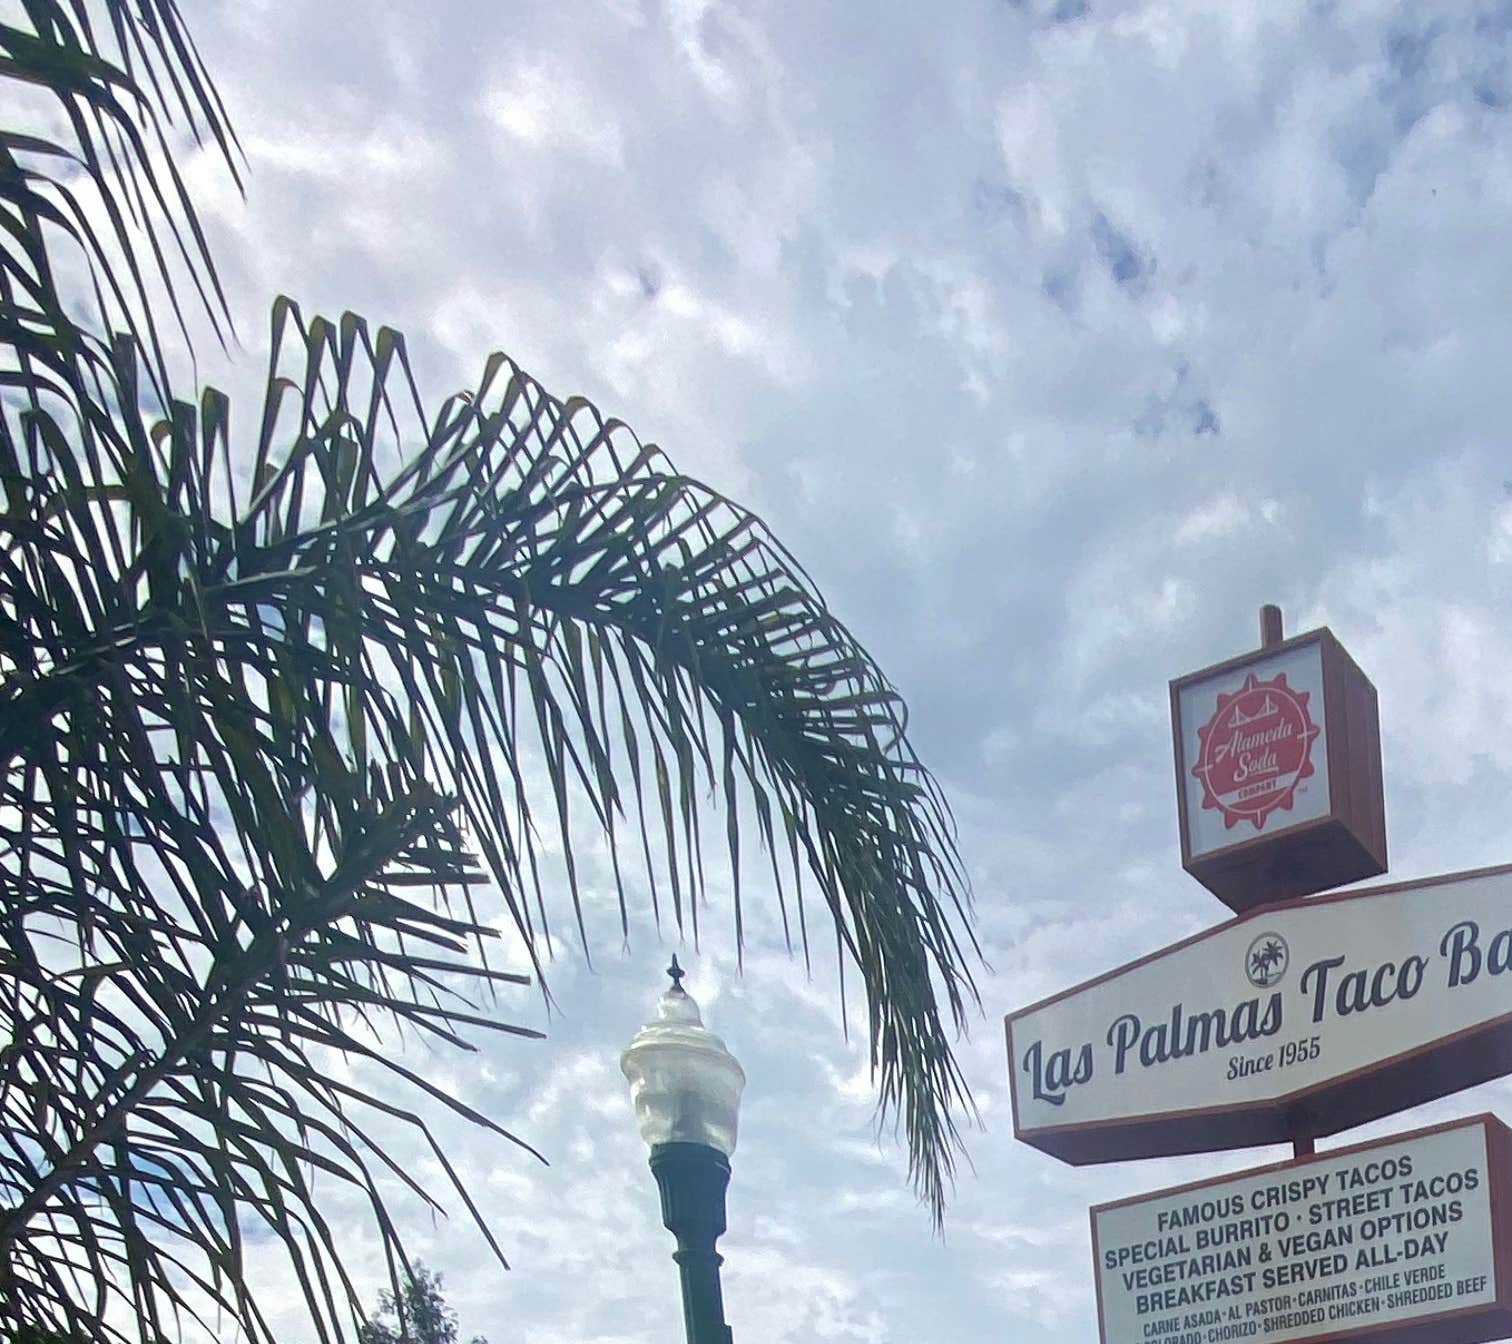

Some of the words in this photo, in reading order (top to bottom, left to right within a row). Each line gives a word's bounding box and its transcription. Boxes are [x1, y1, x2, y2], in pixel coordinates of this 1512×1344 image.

[1215, 717, 1293, 762] Alameda
[1233, 747, 1279, 782] Soda
[1238, 779, 1277, 799] COMPANY
[1023, 1040, 1093, 1106] Las
[1107, 992, 1282, 1074] Palmas
[1301, 954, 1429, 1023] Taco
[1227, 1053, 1274, 1081] Since
[1278, 1036, 1321, 1068] 1955
[1105, 1234, 1190, 1270] SPECIAL
[1196, 1212, 1290, 1249] BURRITO
[1308, 1187, 1393, 1225] STREET
[1400, 1168, 1479, 1204] TACOS
[1157, 1195, 1244, 1232] FAMOUS
[1250, 1174, 1330, 1210] CRISPY
[1336, 1155, 1413, 1191] TACOS
[1122, 1246, 1252, 1291] VEGETARIAN
[1258, 1242, 1272, 1263] &
[1278, 1224, 1353, 1258] VEGAN
[1360, 1201, 1463, 1240] OPTIONS
[1136, 1271, 1256, 1315] BREAKFAST
[1262, 1254, 1348, 1289] SERVED
[1355, 1231, 1448, 1270] ALL-DAY
[1143, 1317, 1180, 1337] CARNE
[1183, 1309, 1222, 1330] ASADA
[1228, 1305, 1242, 1320] AL
[1245, 1295, 1291, 1317] PASTOR
[1298, 1281, 1357, 1307] CARNITAS
[1364, 1273, 1400, 1294] CHILE
[1404, 1264, 1446, 1286] VERDE
[1208, 1320, 1257, 1343] CHORIZO
[1263, 1306, 1325, 1333] SHREDDED
[1328, 1297, 1380, 1319] CHICKEN
[1386, 1282, 1453, 1309] SHREDDED
[1456, 1275, 1487, 1295] BEEF
